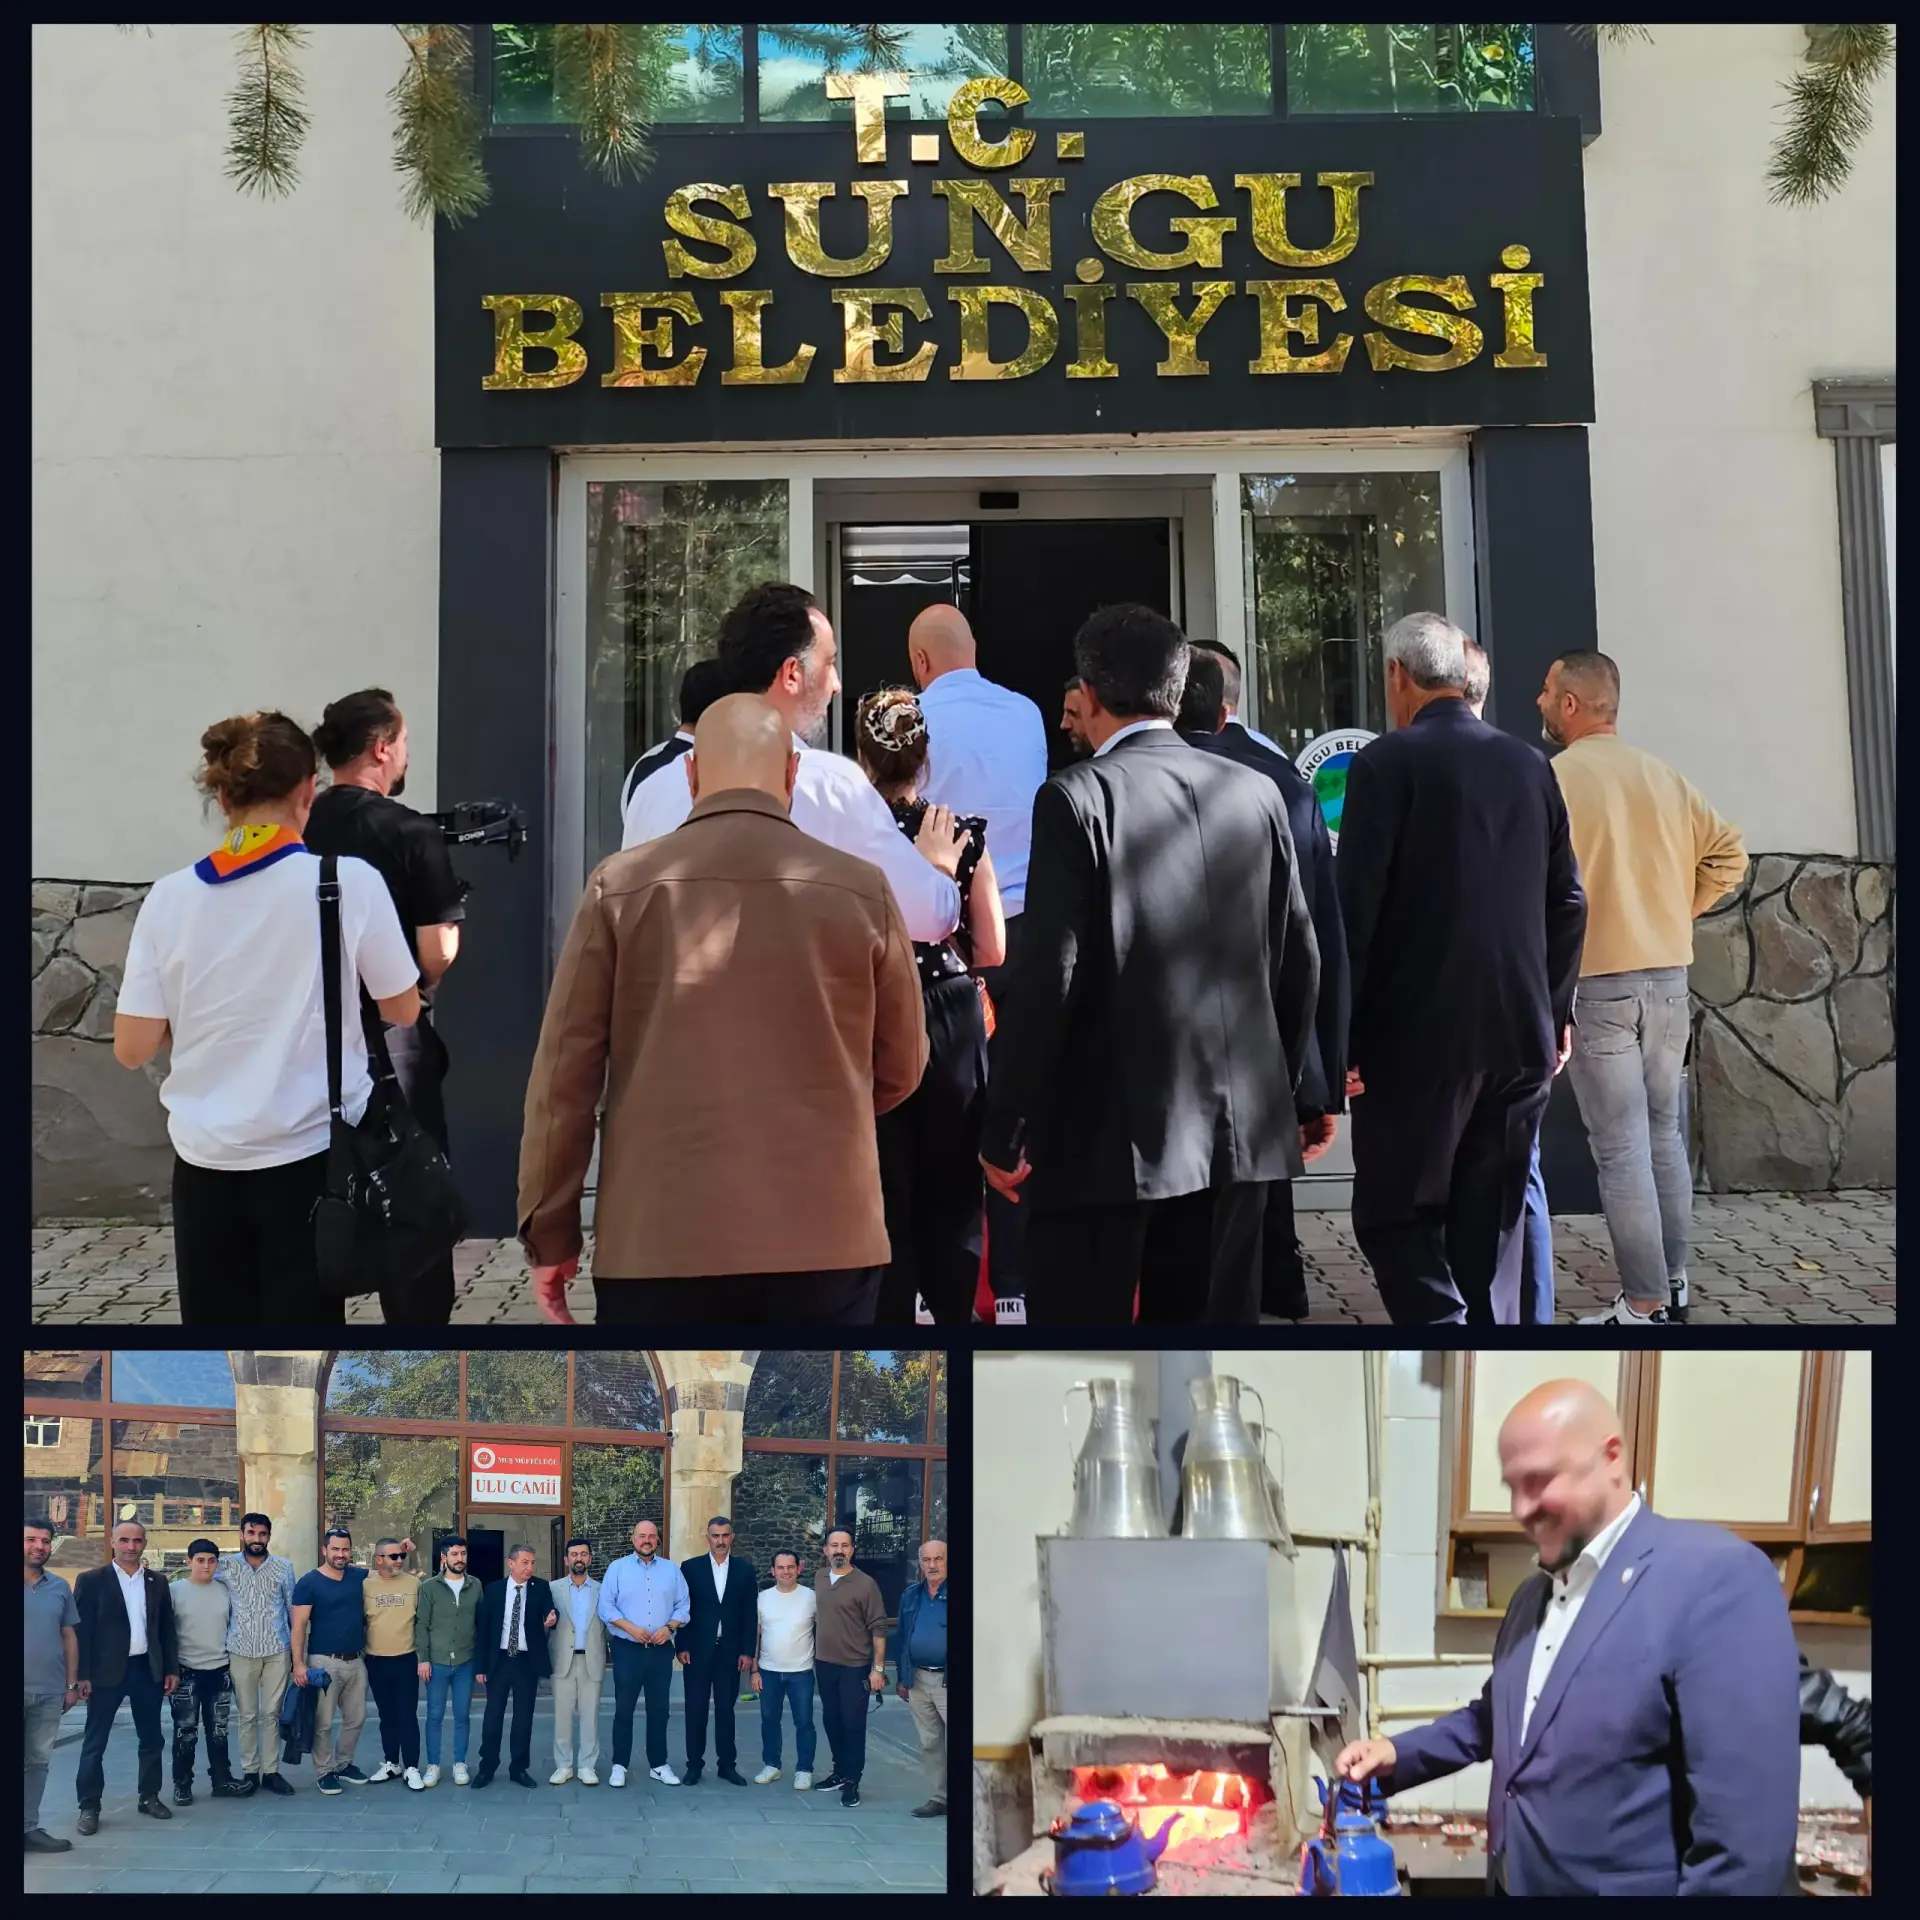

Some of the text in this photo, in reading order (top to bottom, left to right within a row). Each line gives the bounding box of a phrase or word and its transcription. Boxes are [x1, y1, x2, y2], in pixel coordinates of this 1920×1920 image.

[825, 71, 1085, 168] T.C.
[661, 171, 1375, 281] SUNGU
[480, 244, 1549, 392] BELEDİYESİ
[1301, 740, 1360, 782] UNGU BEL
[475, 1479, 507, 1493] ULU
